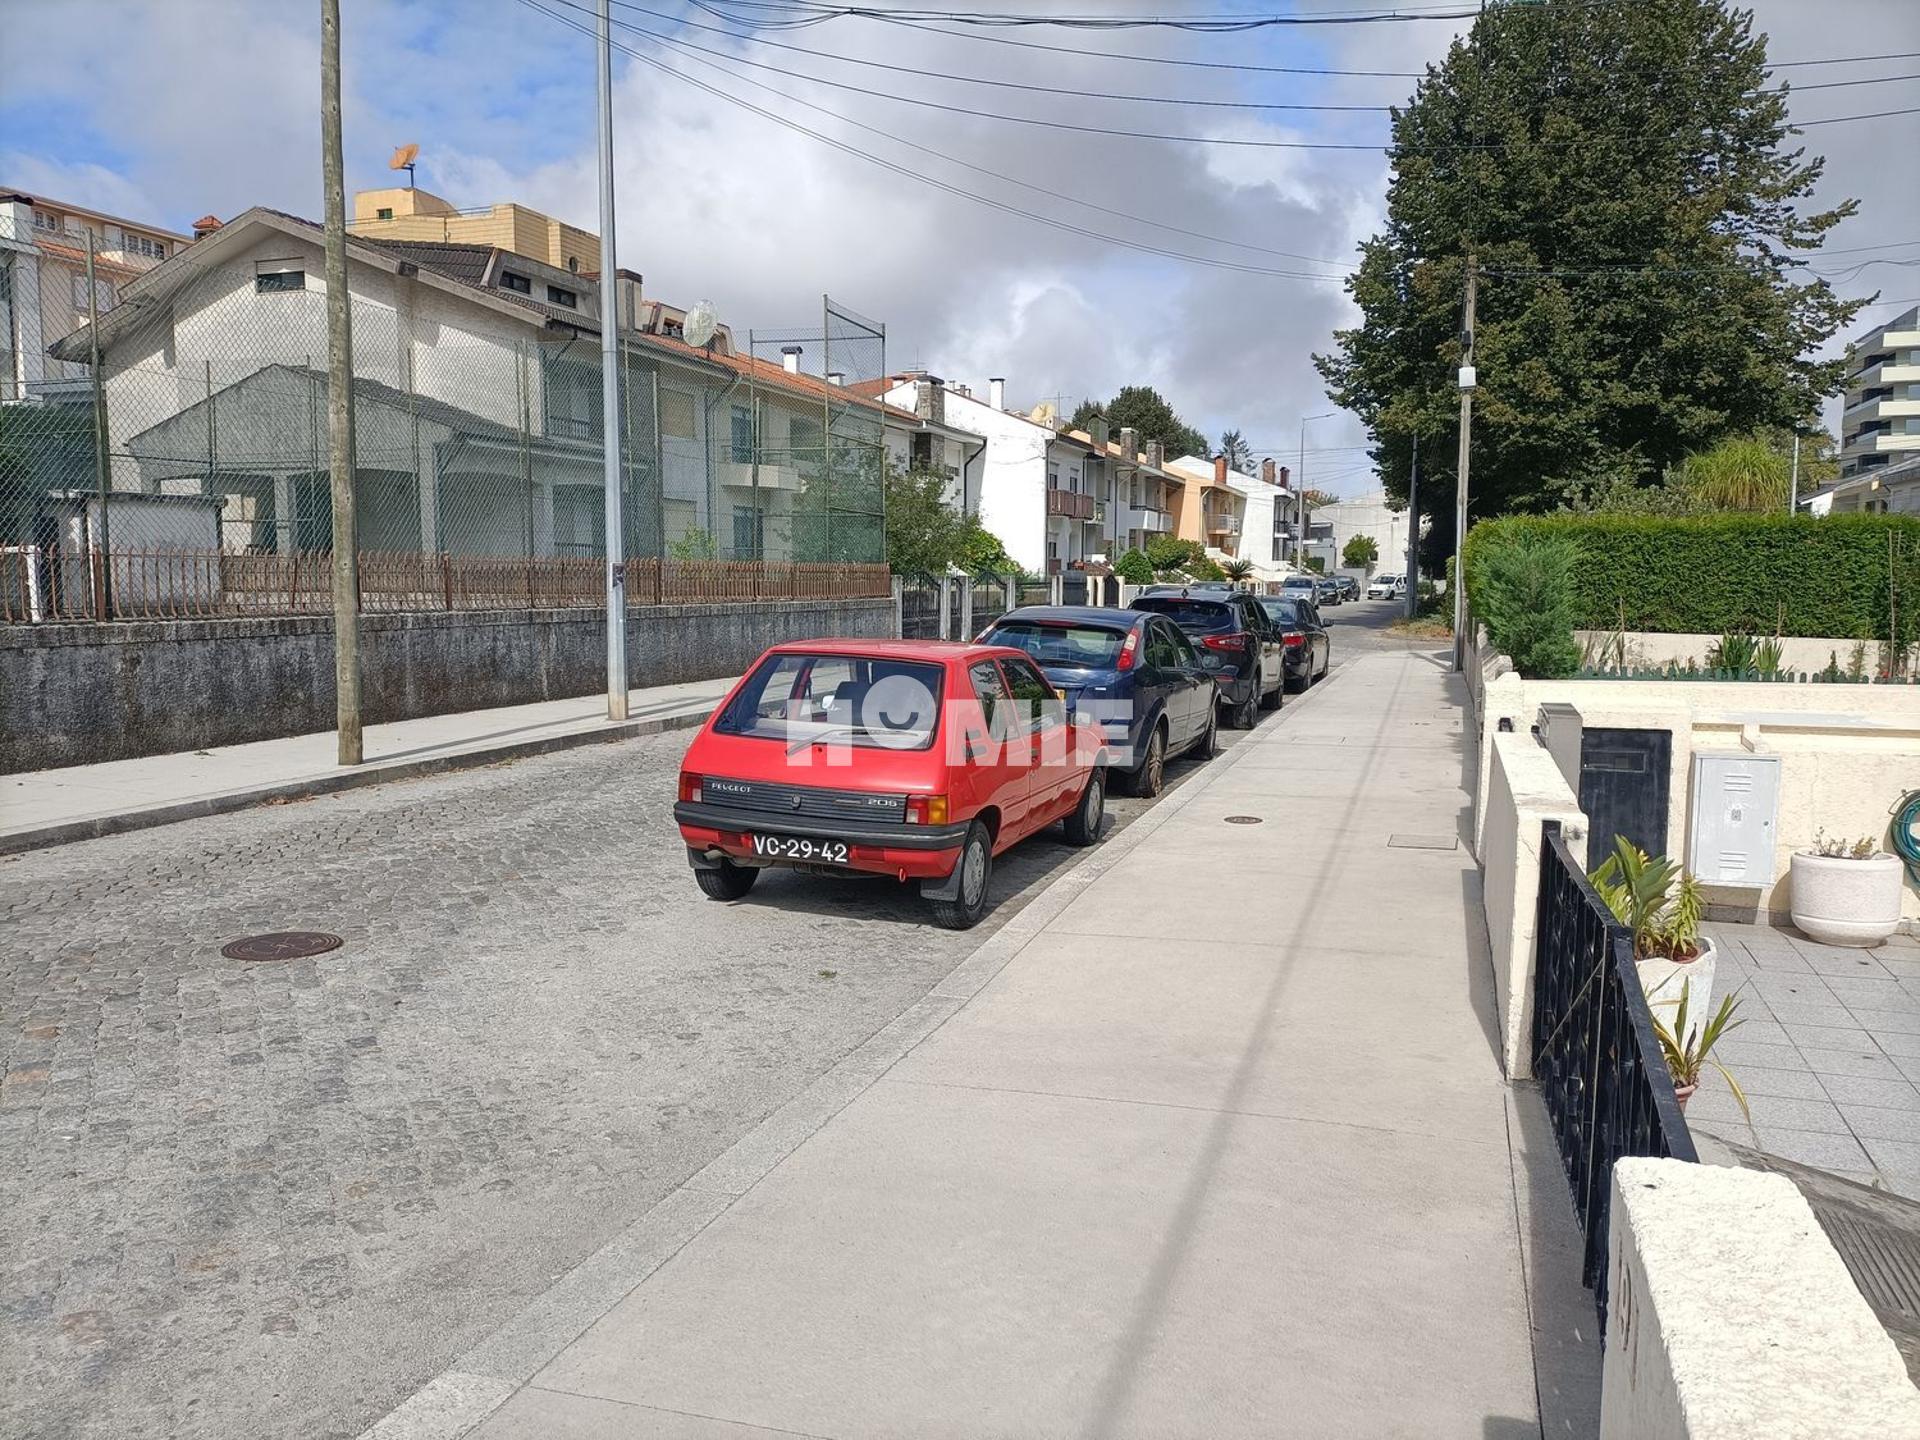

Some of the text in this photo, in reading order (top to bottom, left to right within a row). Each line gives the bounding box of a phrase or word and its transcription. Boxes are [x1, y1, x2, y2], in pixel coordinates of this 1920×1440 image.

[711, 782, 752, 793] PEUGEOT
[867, 798, 898, 807] 205
[753, 834, 848, 862] VC-29-42
